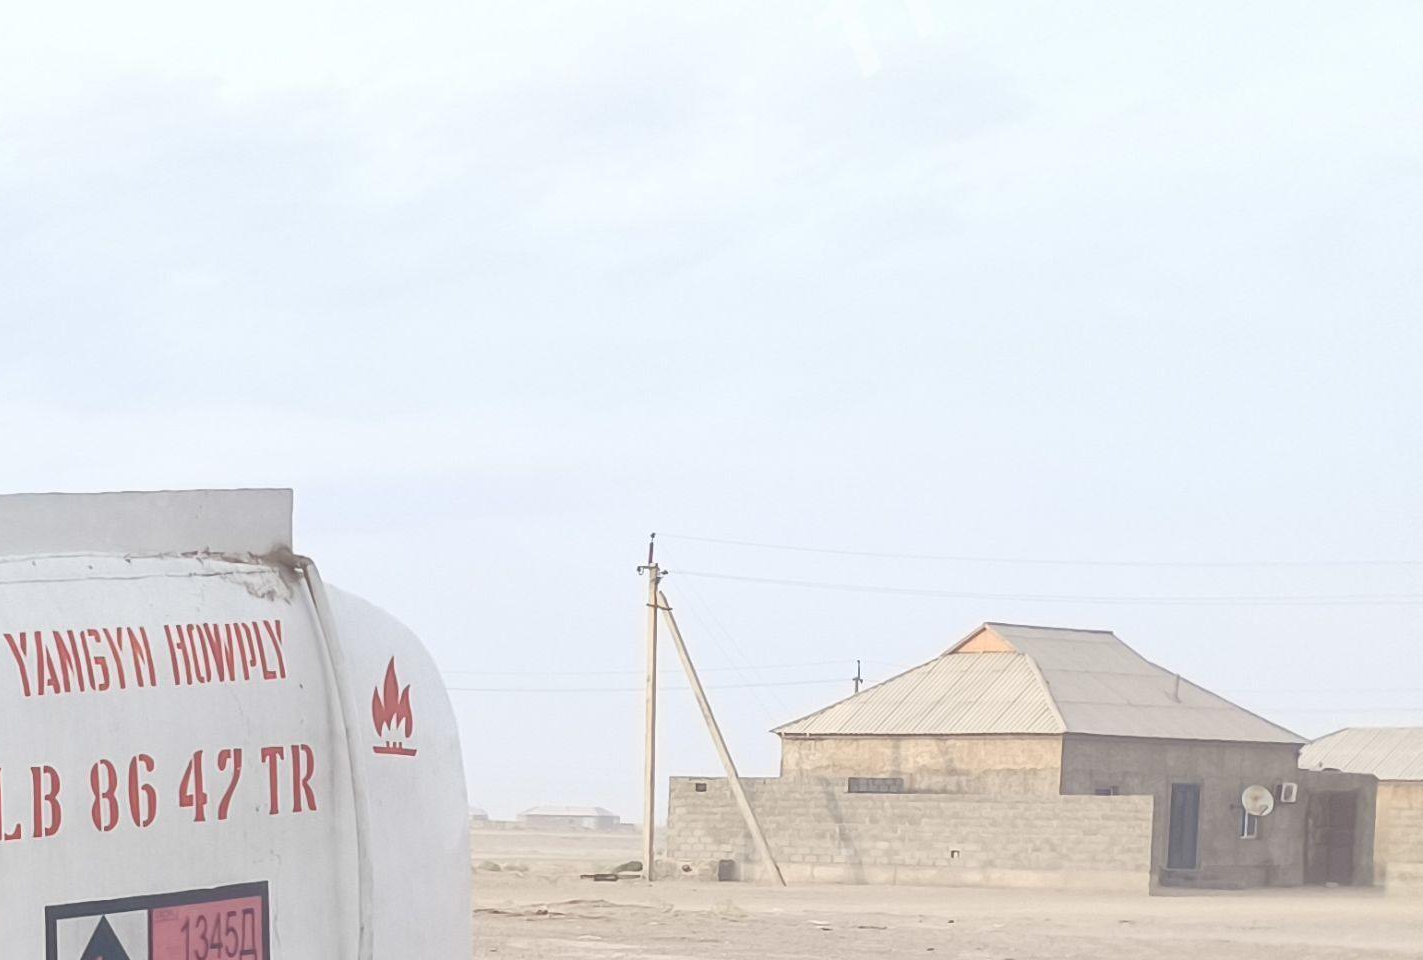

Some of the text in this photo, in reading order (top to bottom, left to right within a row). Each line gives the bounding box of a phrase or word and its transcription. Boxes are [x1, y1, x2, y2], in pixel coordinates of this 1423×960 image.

[3, 619, 287, 698] YANGYN HOWPLY
[90, 753, 158, 833] 86
[178, 748, 243, 823] 47
[260, 743, 318, 816] TR
